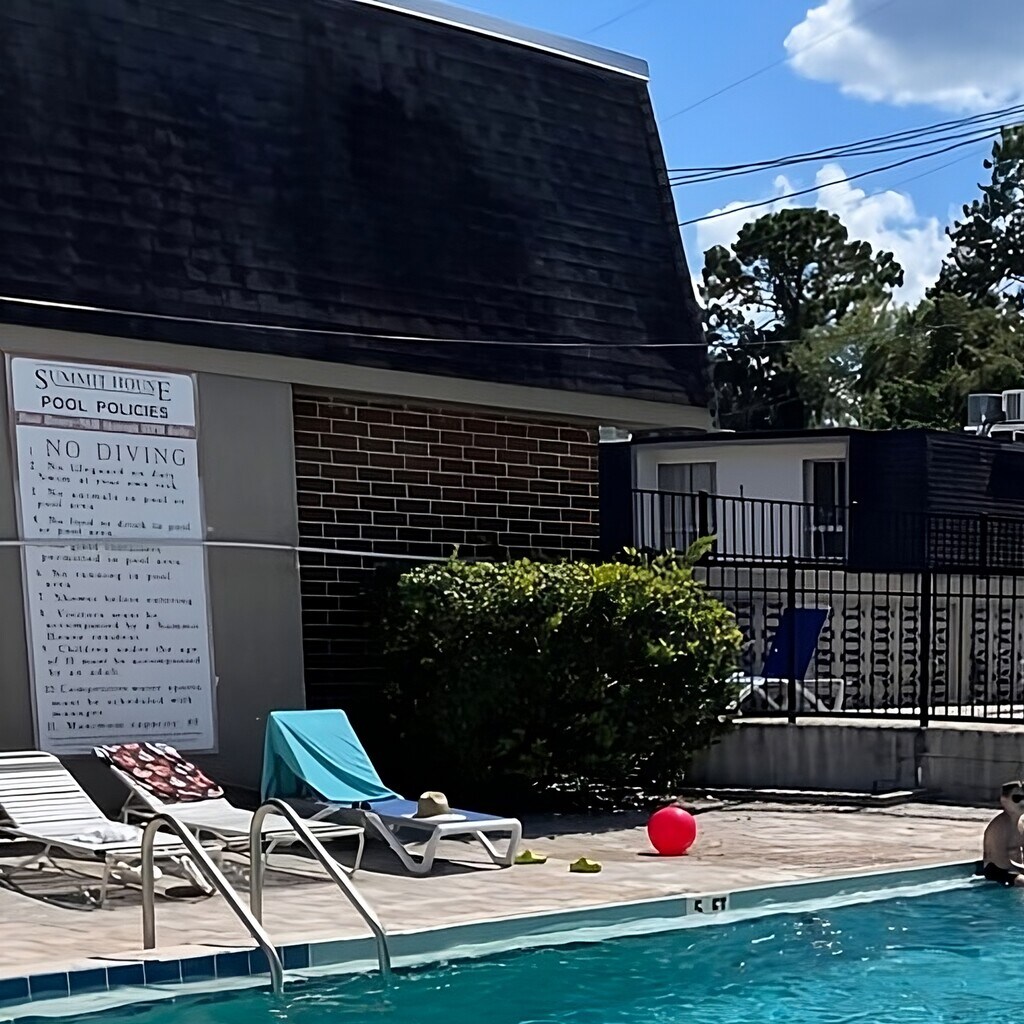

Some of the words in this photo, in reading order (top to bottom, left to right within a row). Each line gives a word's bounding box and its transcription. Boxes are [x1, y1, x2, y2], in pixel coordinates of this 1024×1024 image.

[41, 395, 88, 412] POOL
[96, 400, 169, 419] POLICIES
[45, 438, 81, 459] NO
[96, 442, 187, 467] DIVING
